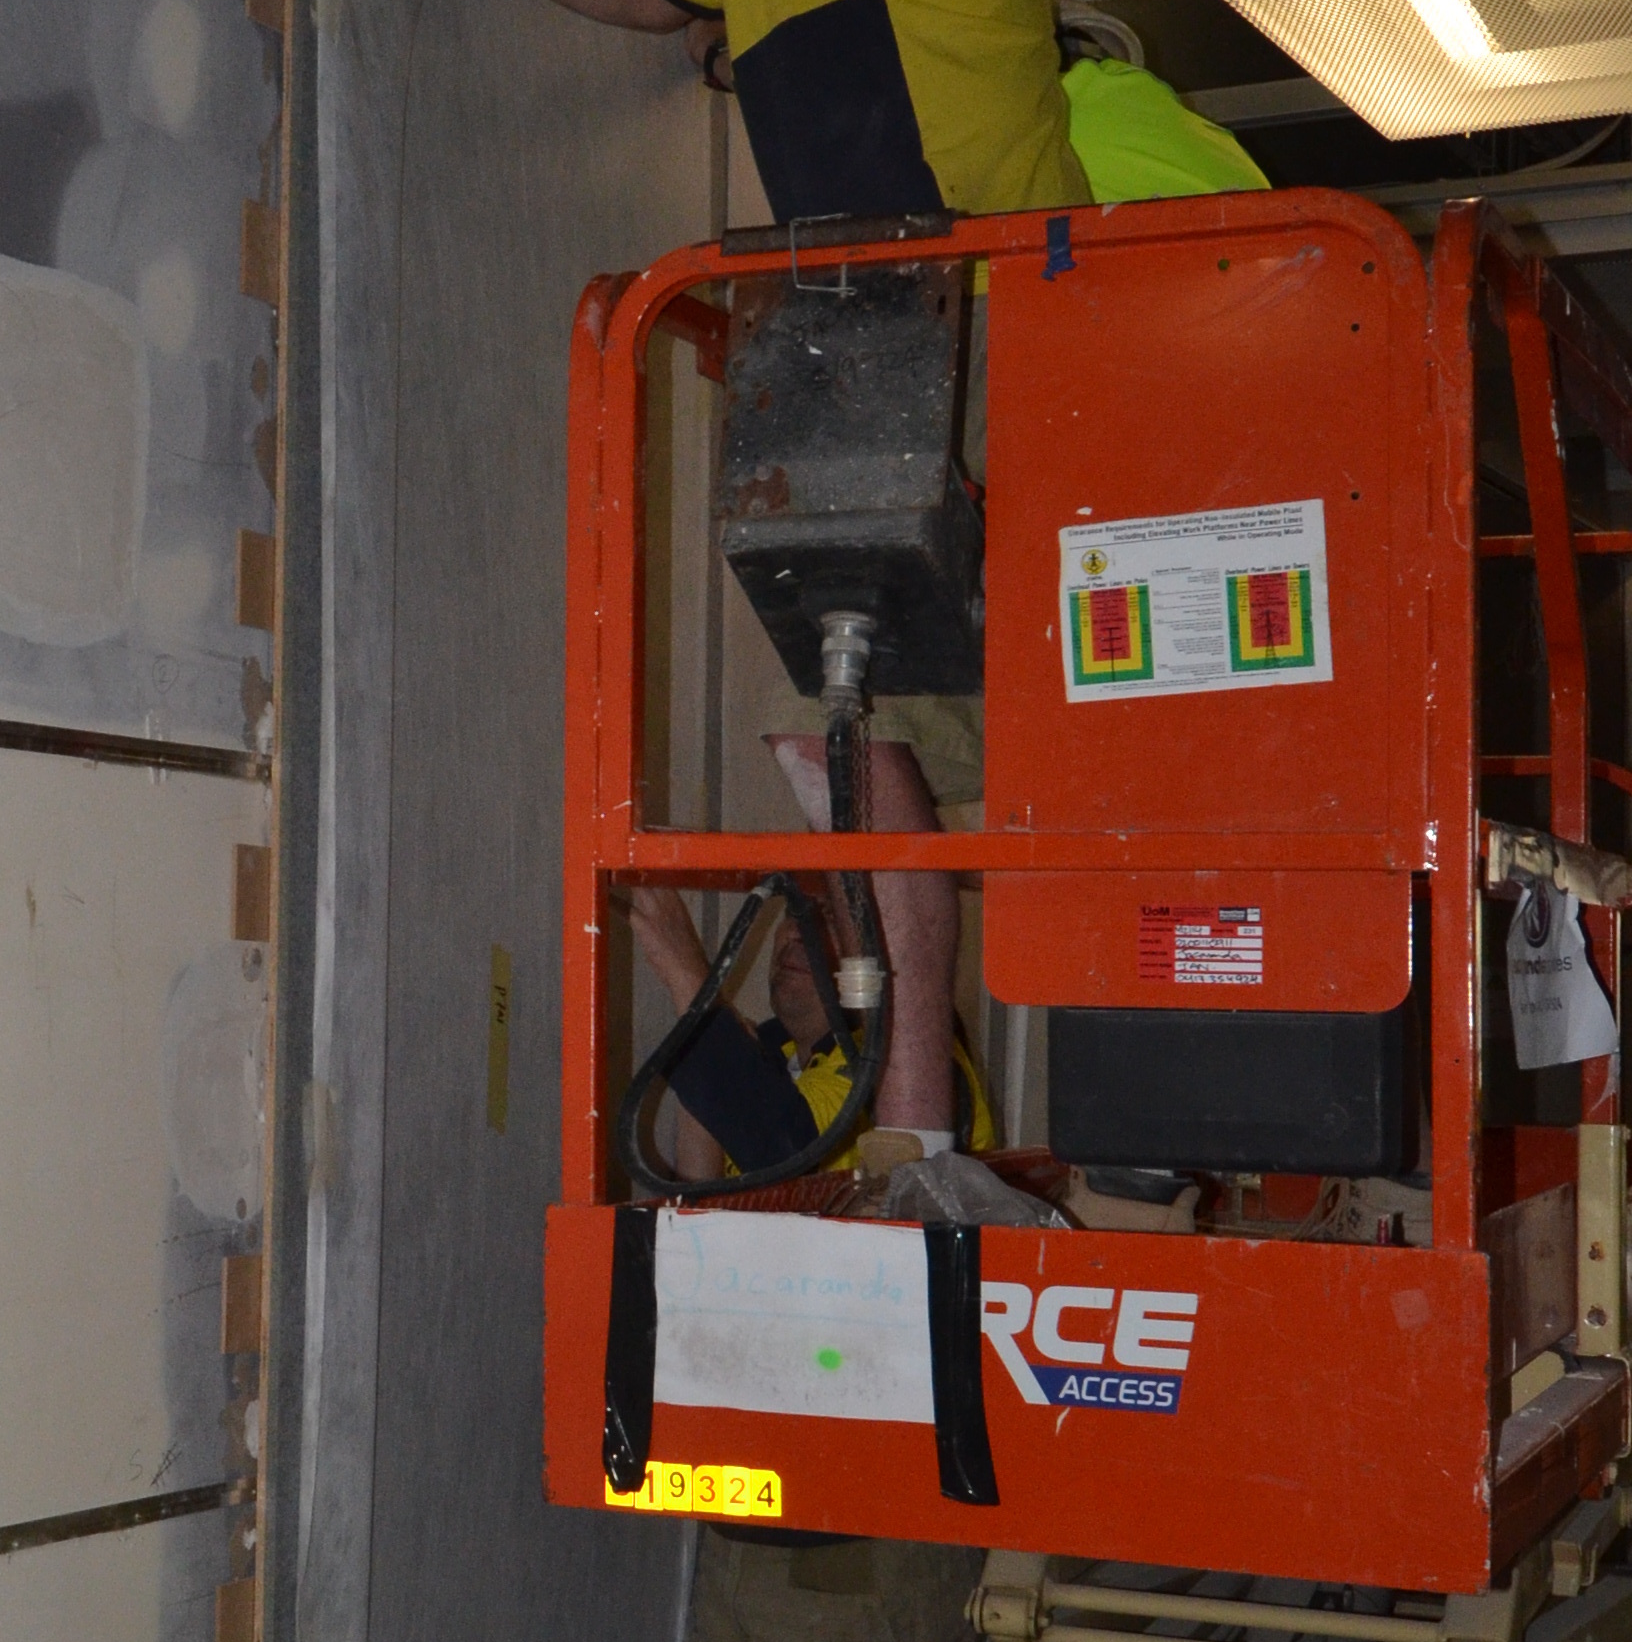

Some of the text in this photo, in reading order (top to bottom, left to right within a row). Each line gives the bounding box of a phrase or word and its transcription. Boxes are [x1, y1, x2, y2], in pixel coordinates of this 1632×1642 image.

[1259, 518, 1281, 526] Power
[662, 1224, 905, 1305] Jacaranda
[1059, 1375, 1175, 1407] ACCESS
[613, 1469, 775, 1508] 19324
